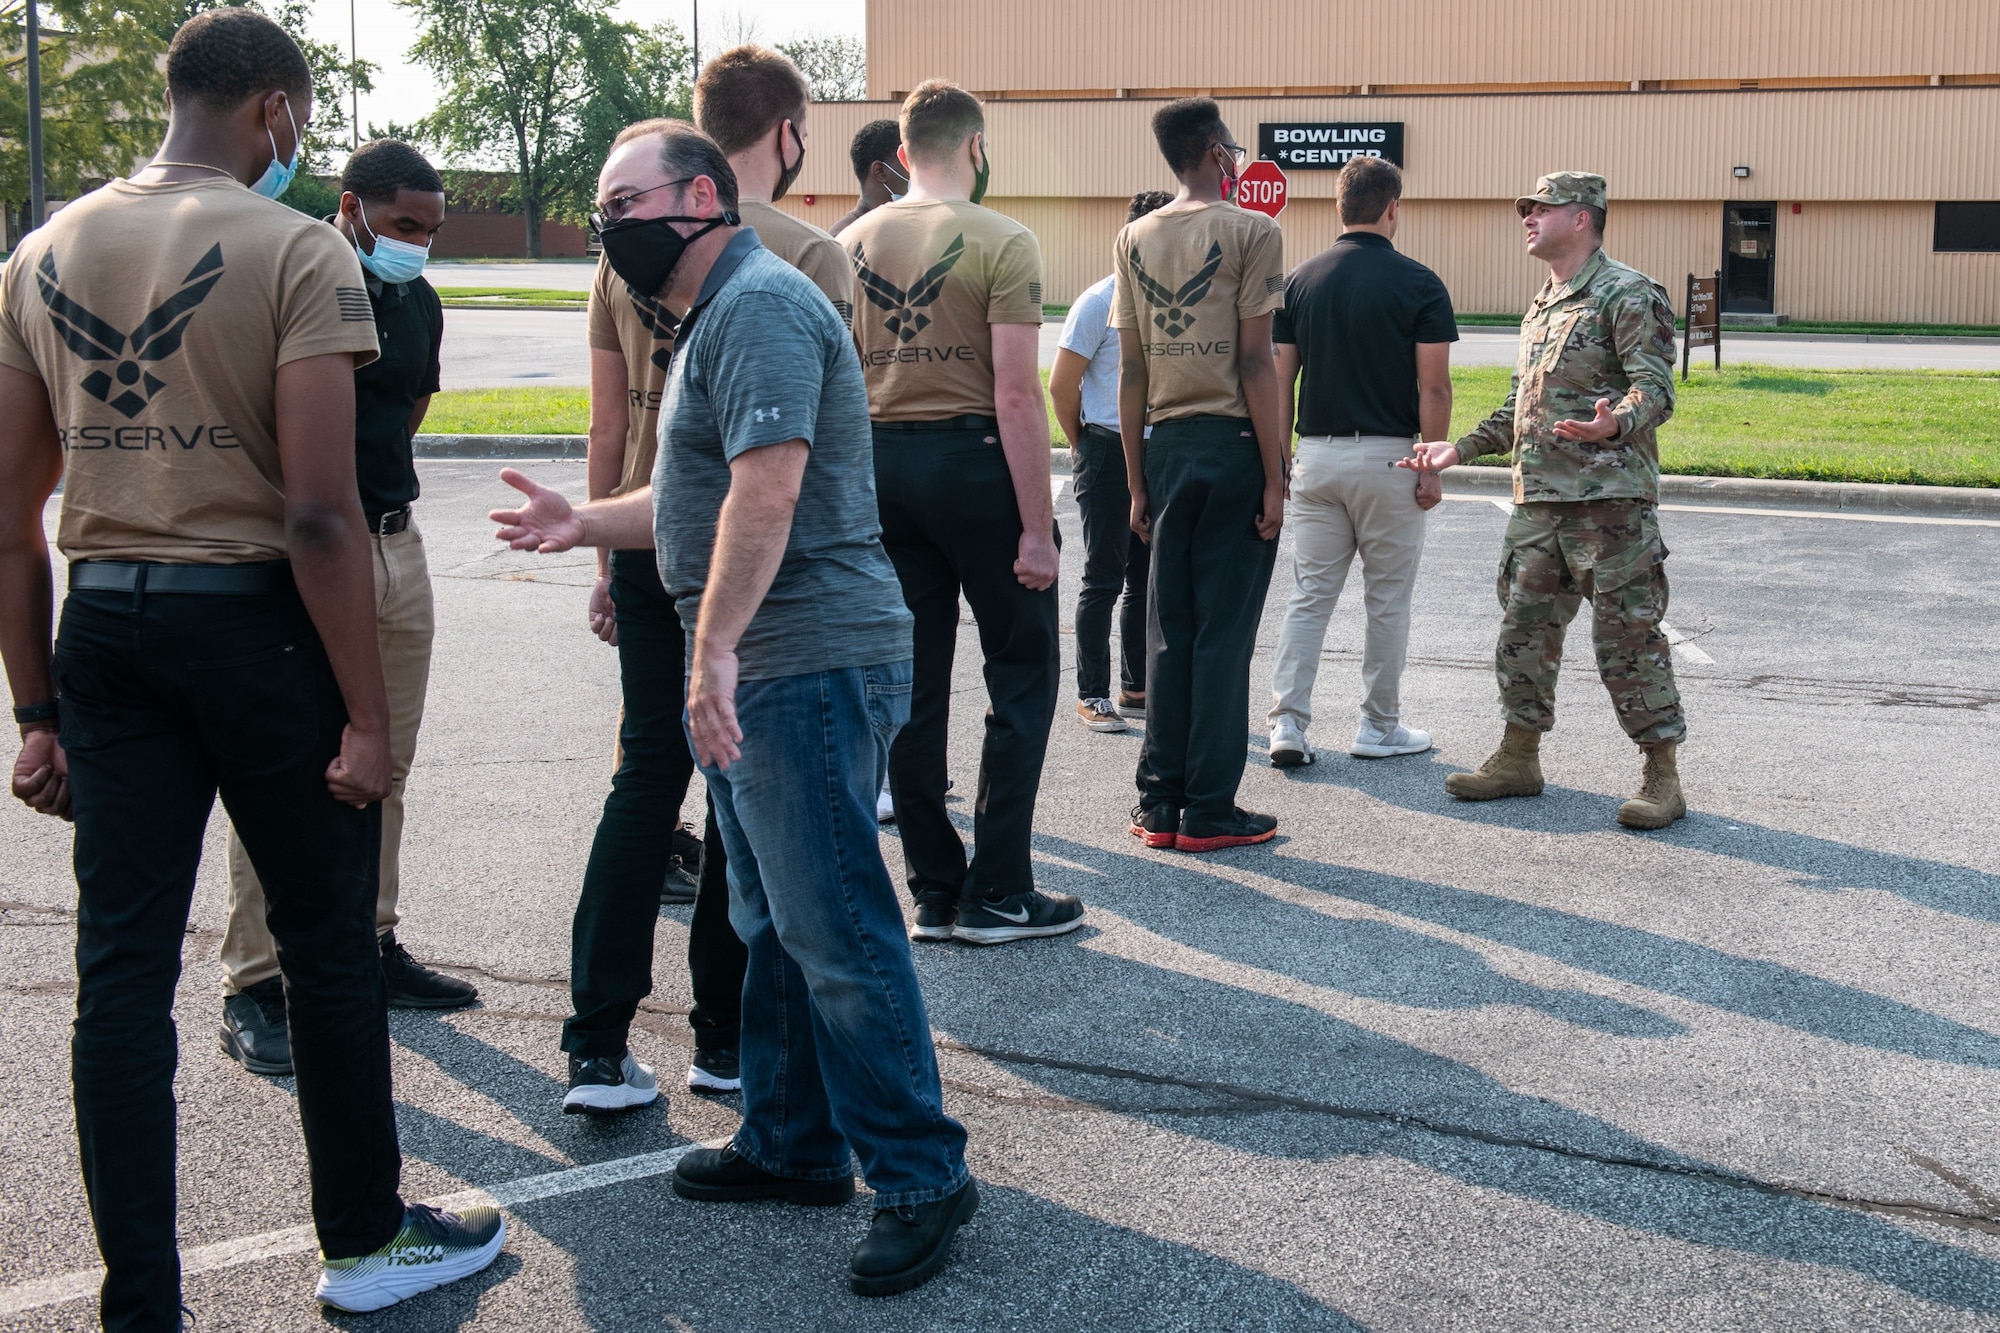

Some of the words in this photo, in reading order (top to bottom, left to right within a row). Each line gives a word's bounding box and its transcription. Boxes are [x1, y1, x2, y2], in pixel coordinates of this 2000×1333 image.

[1273, 129, 1386, 143] BOWLING
[1240, 180, 1284, 204] STOP
[387, 1244, 443, 1266] HOKA
